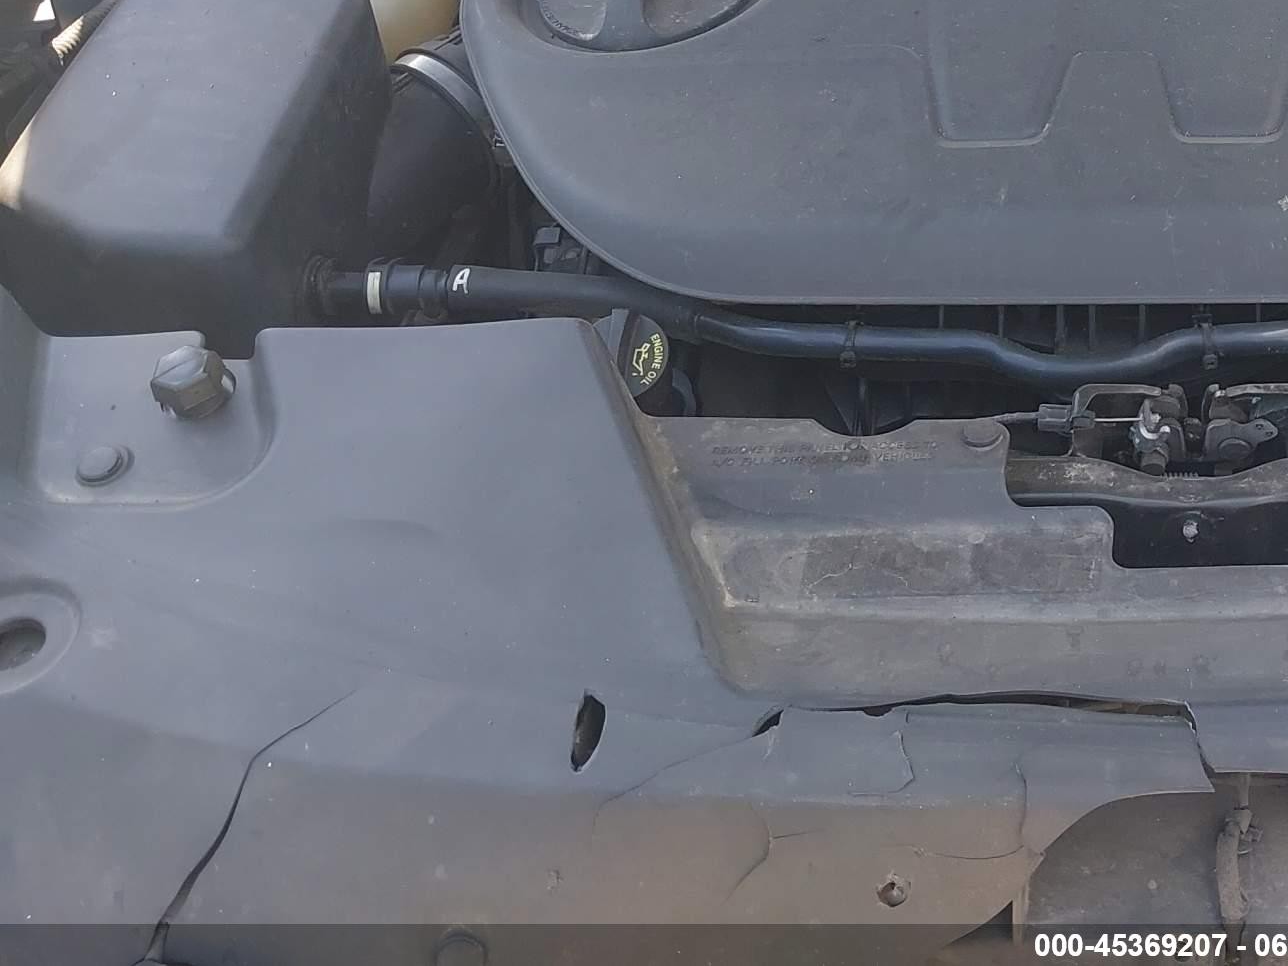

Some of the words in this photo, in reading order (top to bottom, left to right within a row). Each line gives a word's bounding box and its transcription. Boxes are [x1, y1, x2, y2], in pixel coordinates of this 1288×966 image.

[452, 268, 470, 294] A
[651, 333, 663, 369] ENGINE
[640, 371, 656, 385] OIL
